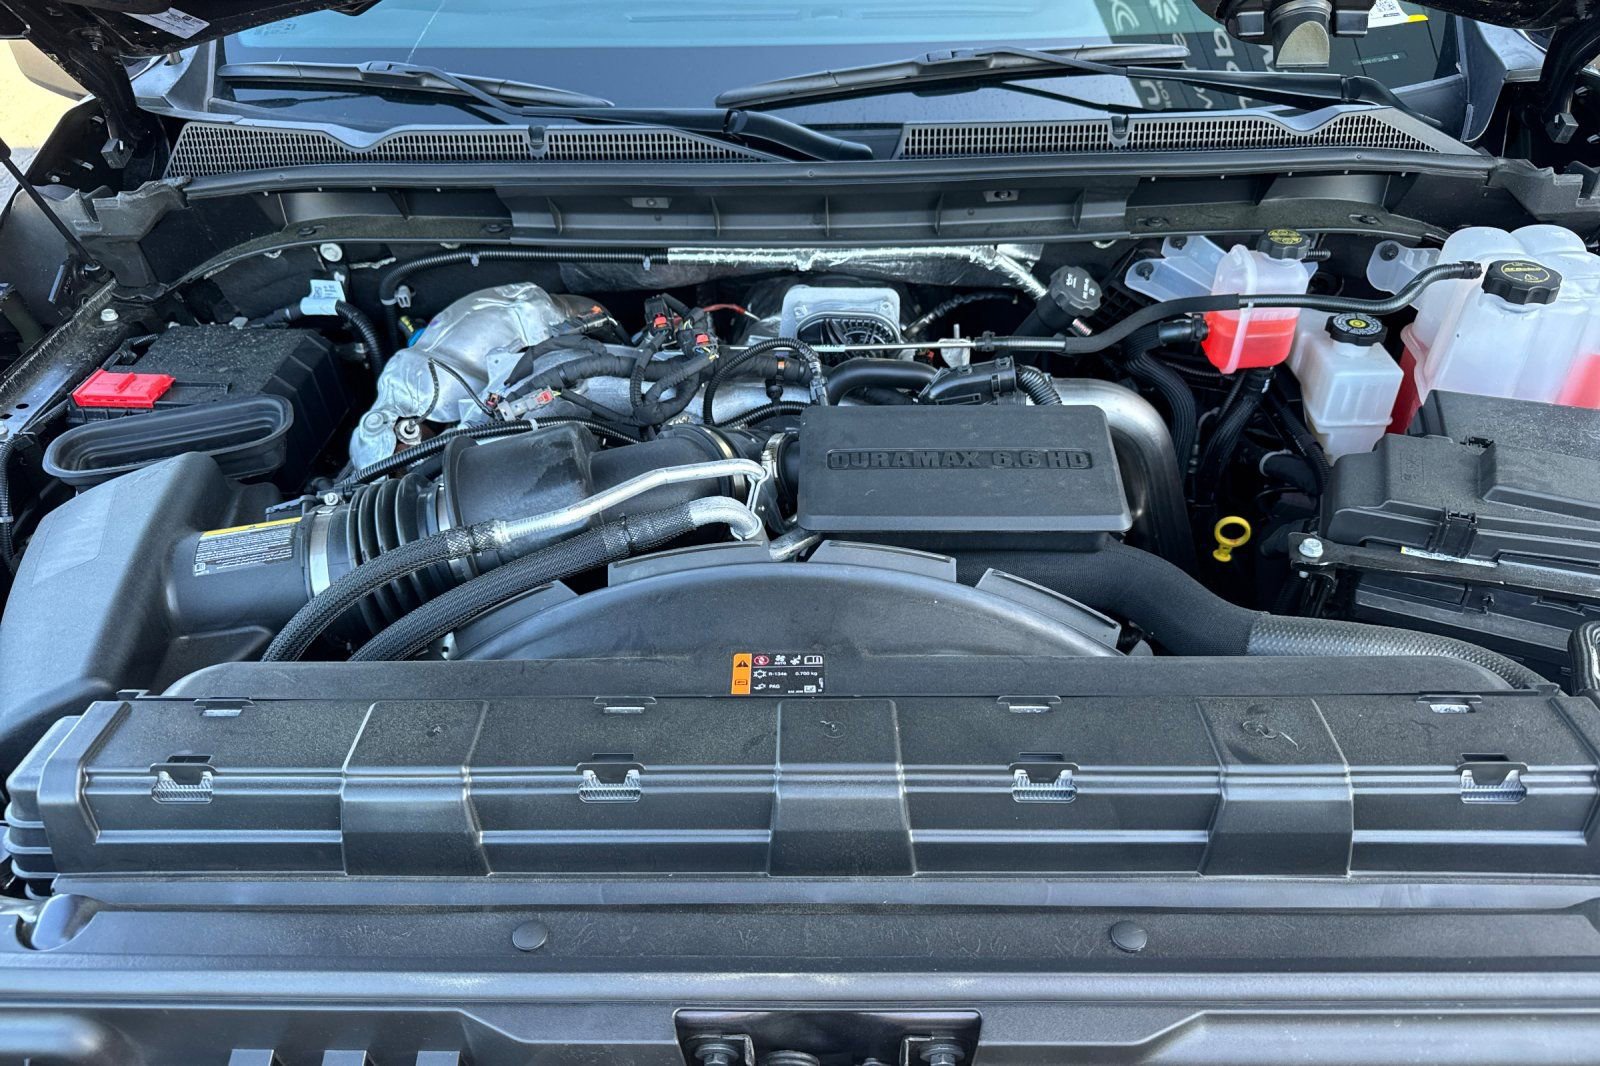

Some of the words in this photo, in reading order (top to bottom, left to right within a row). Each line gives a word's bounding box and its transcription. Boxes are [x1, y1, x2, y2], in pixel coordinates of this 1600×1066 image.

[830, 450, 980, 469] DURAMAX
[992, 450, 1042, 468] 6.6
[1048, 451, 1090, 469] HD
